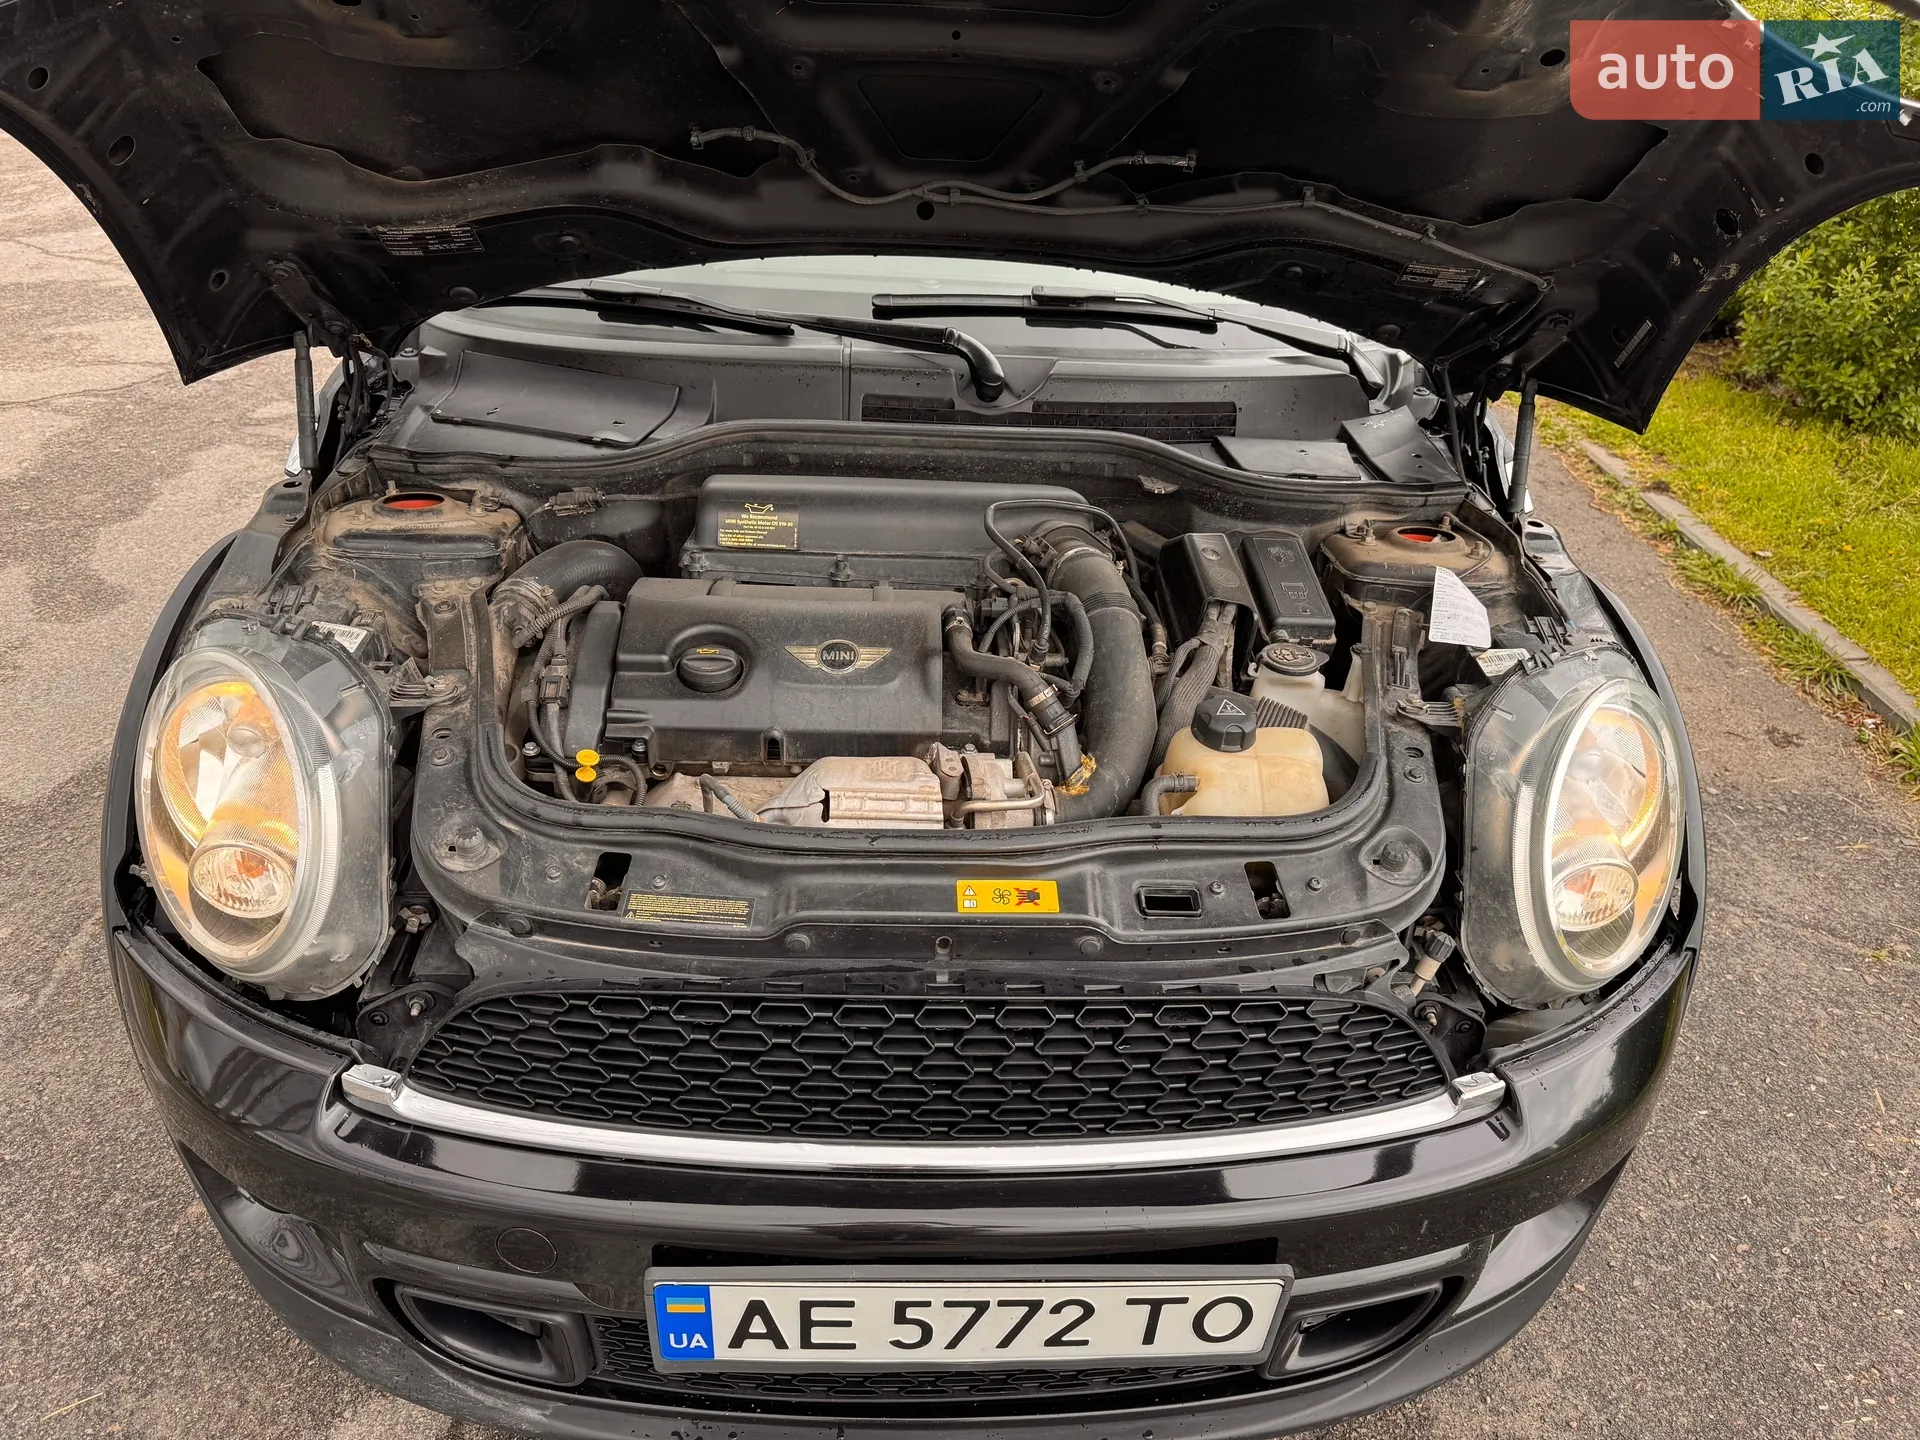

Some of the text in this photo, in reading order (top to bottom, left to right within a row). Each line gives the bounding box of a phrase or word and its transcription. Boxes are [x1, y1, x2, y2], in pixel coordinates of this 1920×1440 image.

[822, 650, 854, 660] MINI
[727, 1296, 1254, 1350] AE 5772 TO
[669, 1333, 708, 1349] UA
